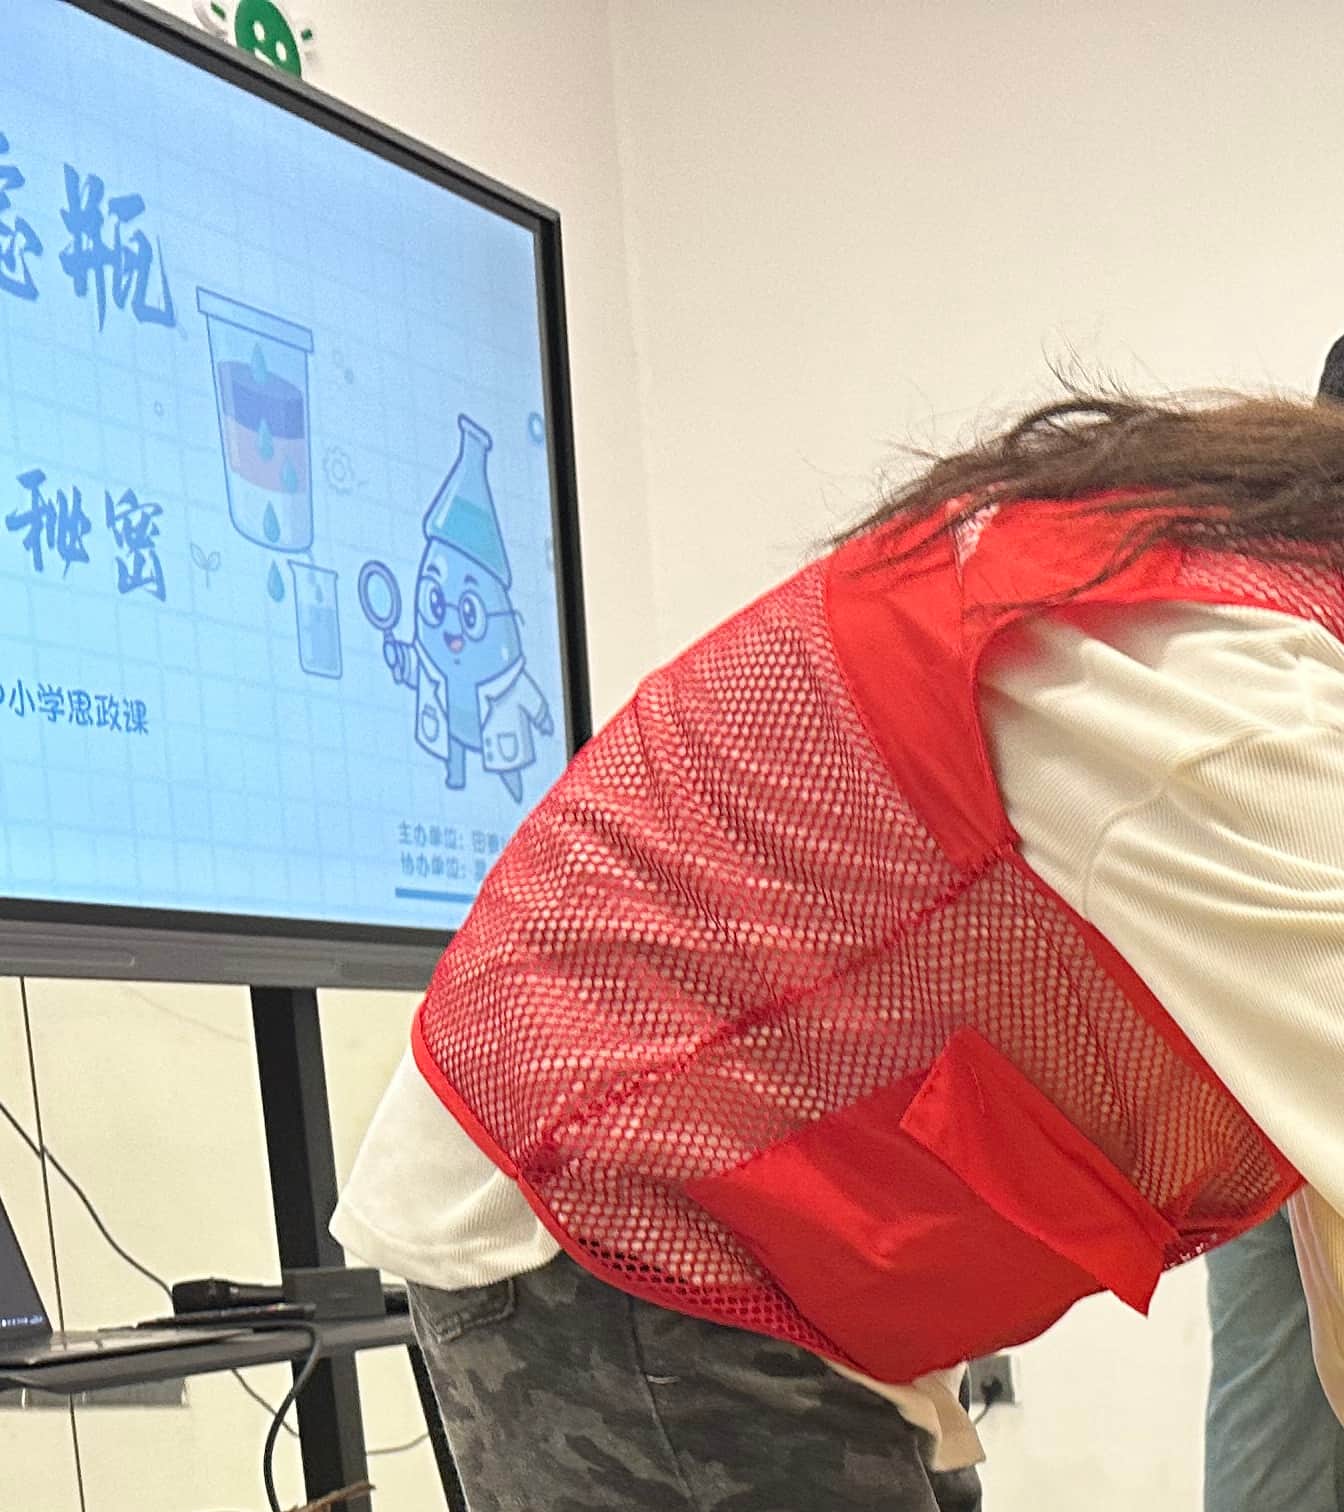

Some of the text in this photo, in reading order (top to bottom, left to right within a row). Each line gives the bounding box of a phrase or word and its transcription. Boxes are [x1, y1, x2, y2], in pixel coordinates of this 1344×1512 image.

[5, 468, 166, 602] 秘密
[0, 678, 149, 735] 小学思政课
